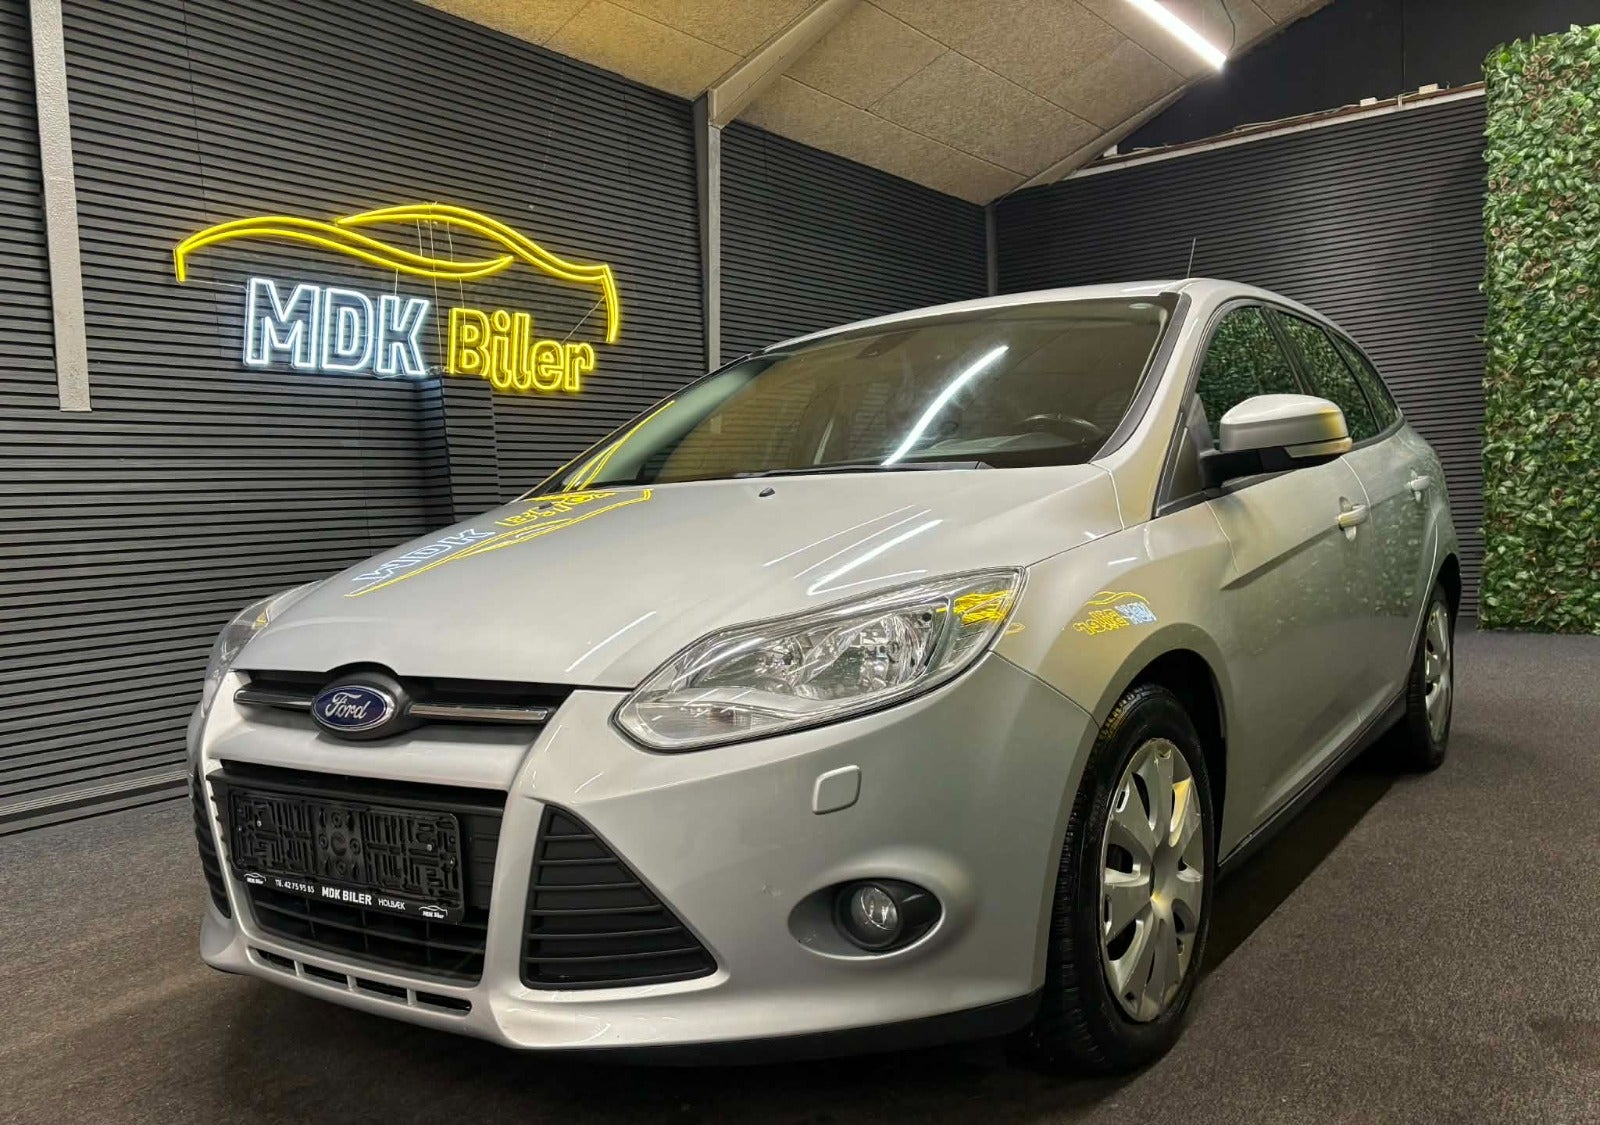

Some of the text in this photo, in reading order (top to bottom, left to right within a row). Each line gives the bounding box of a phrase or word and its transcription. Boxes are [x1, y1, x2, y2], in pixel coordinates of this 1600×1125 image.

[243, 277, 597, 392] MDK Biler
[325, 692, 371, 719] Ford
[321, 886, 341, 900] MDK
[342, 890, 373, 906] BILER
[378, 898, 406, 911] HOLBÆK
